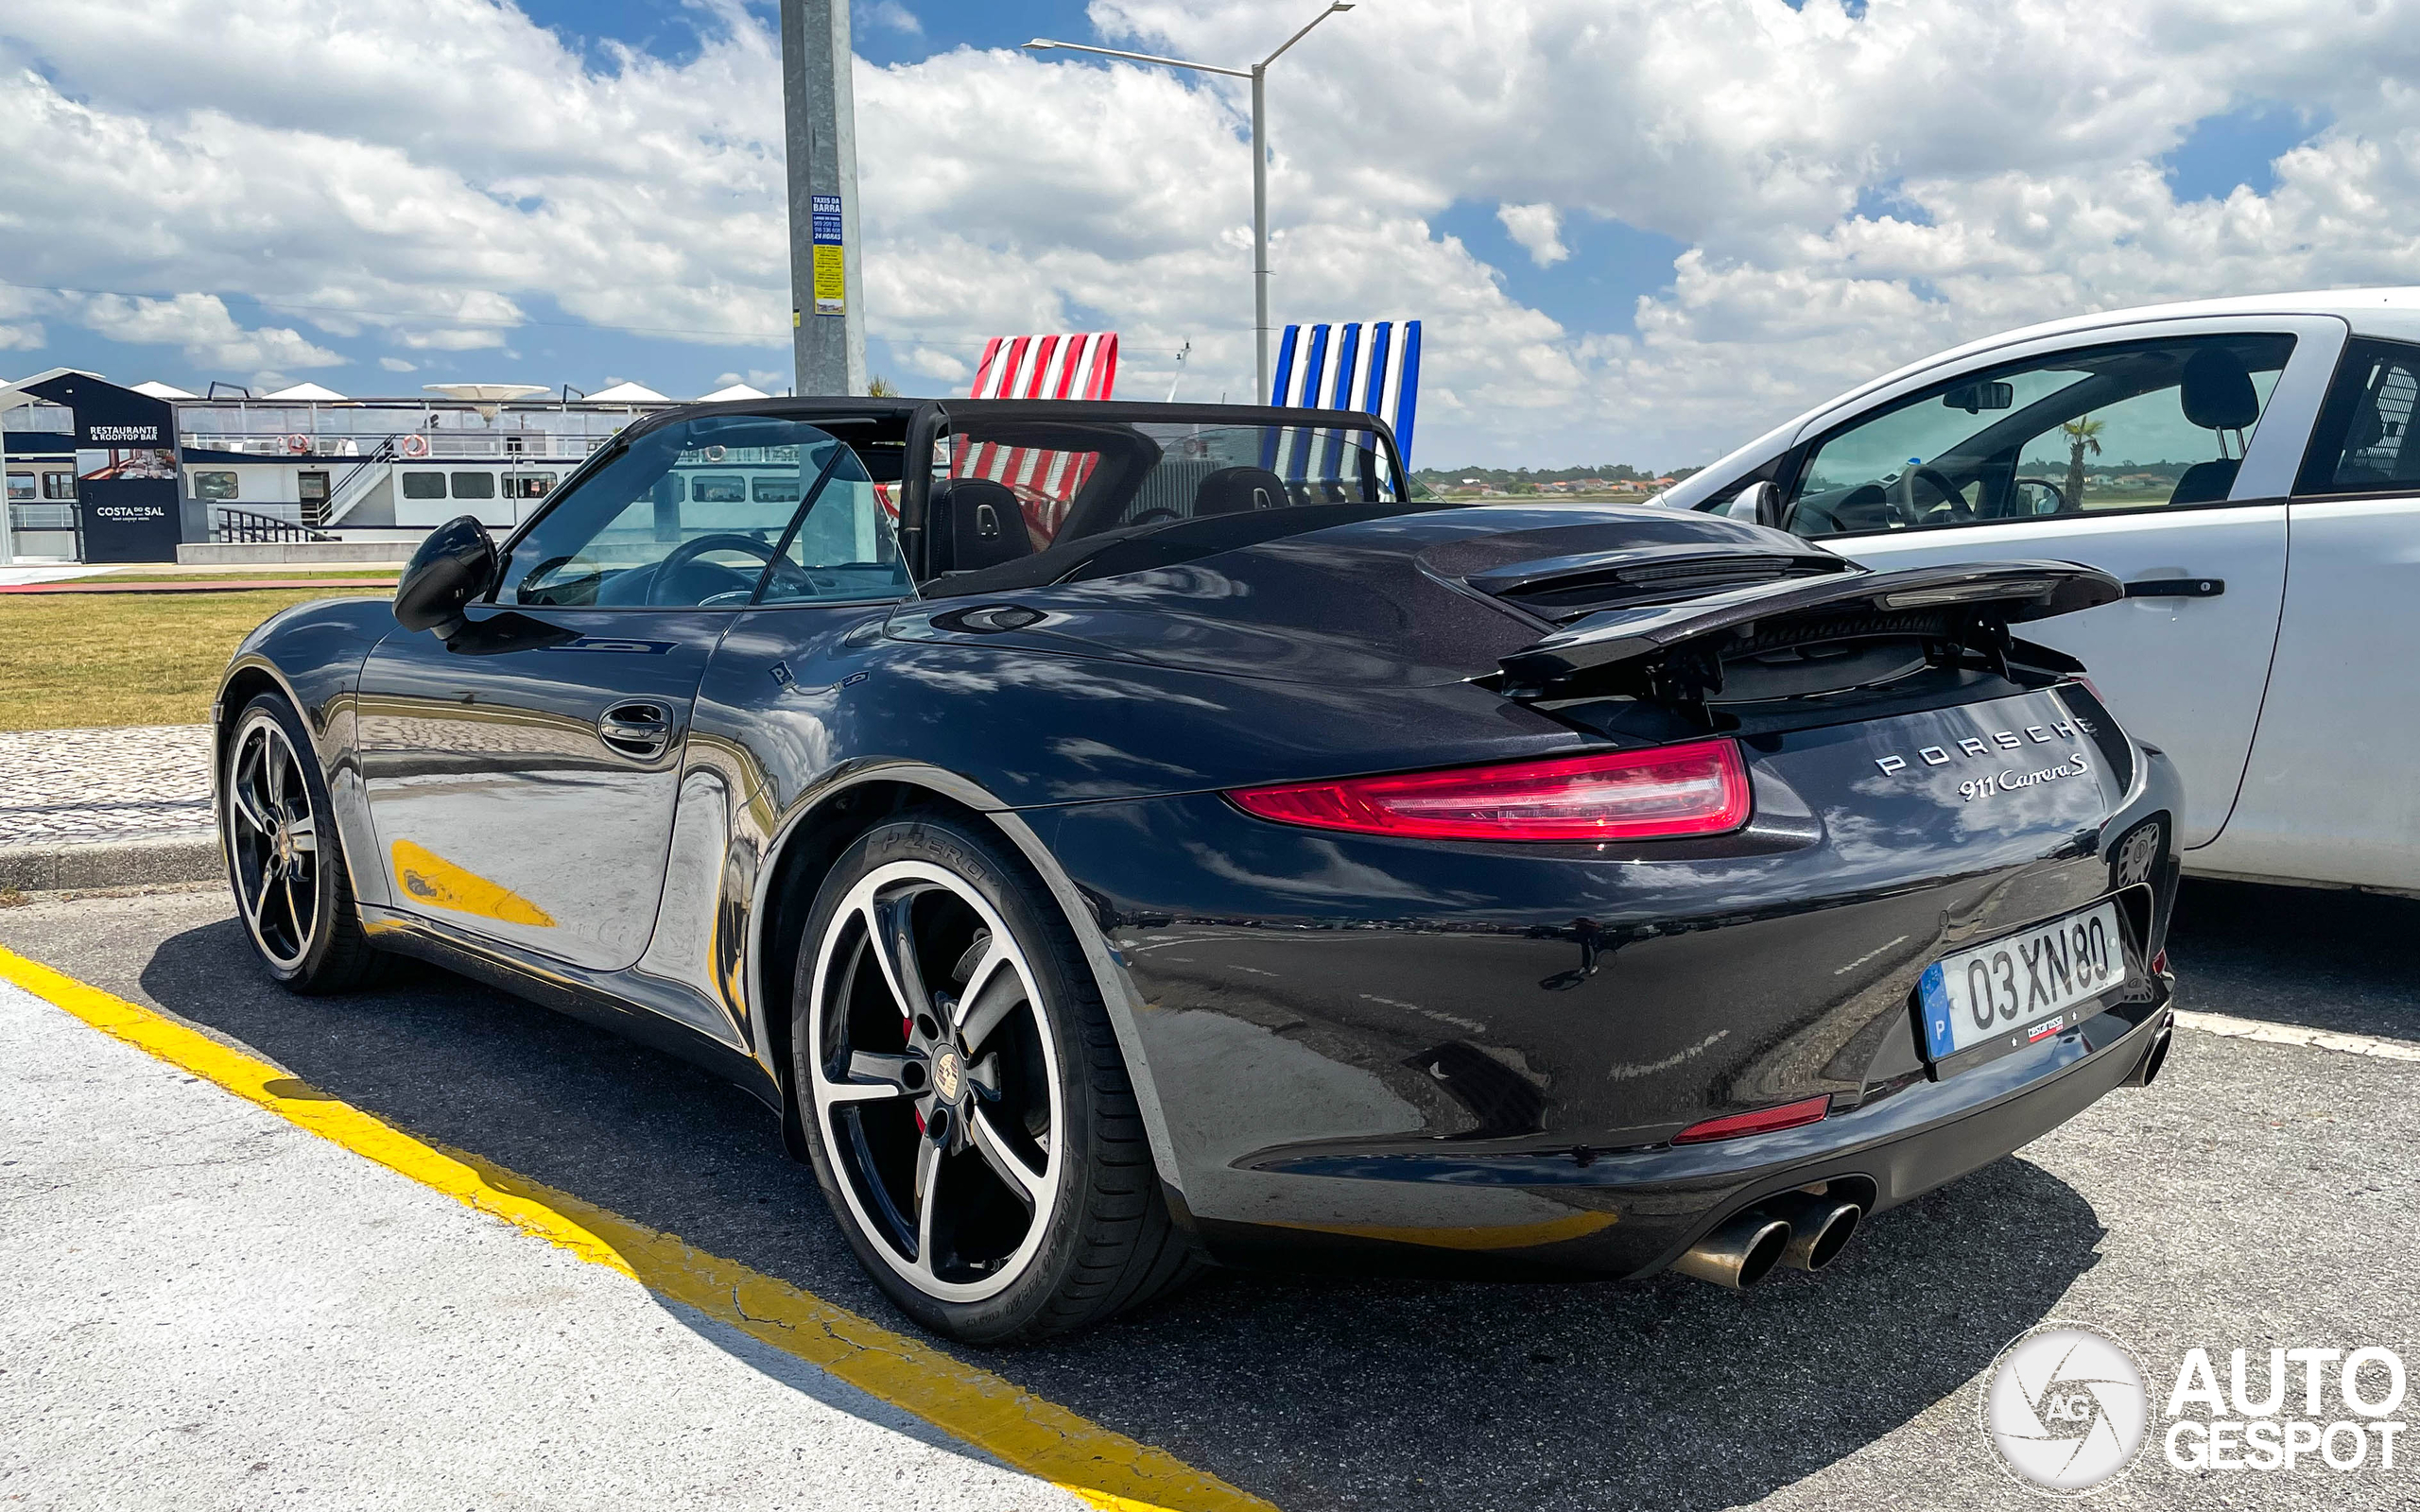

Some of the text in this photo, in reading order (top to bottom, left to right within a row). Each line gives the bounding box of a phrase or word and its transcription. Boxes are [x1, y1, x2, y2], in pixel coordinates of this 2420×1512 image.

[813, 203, 840, 213] BARRA
[90, 426, 158, 435] RESTAURANTE
[96, 507, 133, 516] COSTA
[144, 507, 164, 516] SAL
[1875, 717, 2098, 777] PORSCHE
[1958, 752, 2089, 801] 911 Carrera S
[904, 833, 987, 882] ZERO
[1935, 1020, 1945, 1040] P
